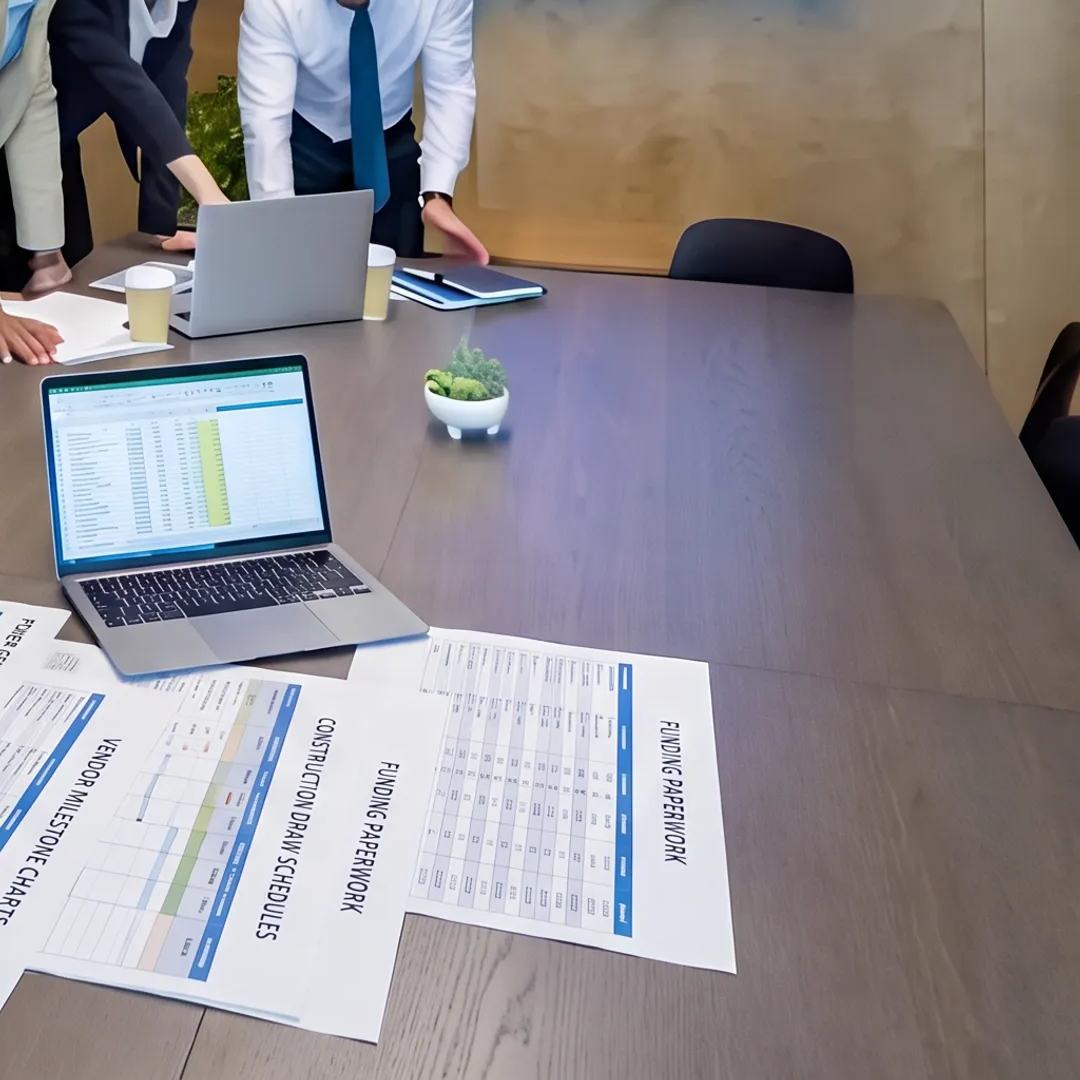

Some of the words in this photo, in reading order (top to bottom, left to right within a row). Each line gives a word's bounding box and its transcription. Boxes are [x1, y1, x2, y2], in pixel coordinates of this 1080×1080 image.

[74, 738, 122, 788] VENDOR
[293, 717, 336, 810] CONSTRUCTION
[660, 720, 683, 776] FUNDING
[26, 789, 89, 866] MILESTONE
[366, 761, 400, 820] FUNDING
[663, 778, 687, 866] PAPERWORK
[281, 811, 311, 855] DRAW
[340, 822, 383, 915] PAPERWORK
[256, 856, 298, 941] SCHEDULES
